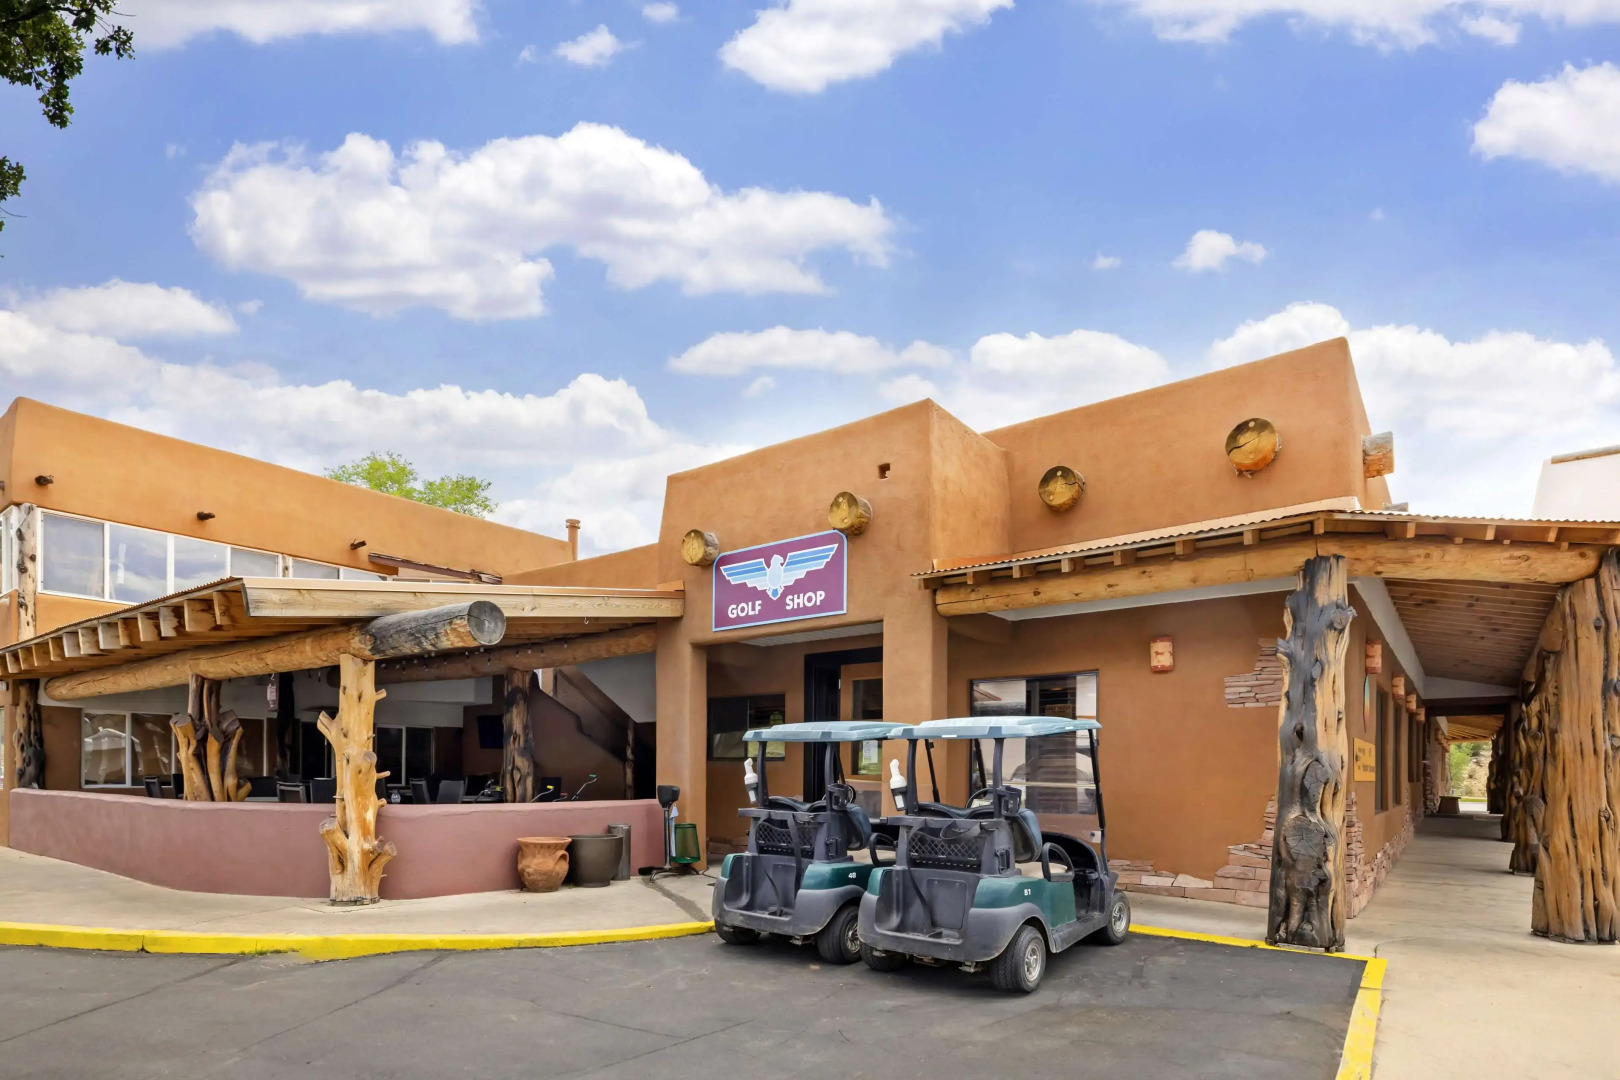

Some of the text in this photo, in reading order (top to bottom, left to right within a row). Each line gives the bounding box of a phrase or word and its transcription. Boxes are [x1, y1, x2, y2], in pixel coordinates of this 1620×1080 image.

[728, 591, 825, 618] GOLF SHOP
[1024, 888, 1031, 896] 51
